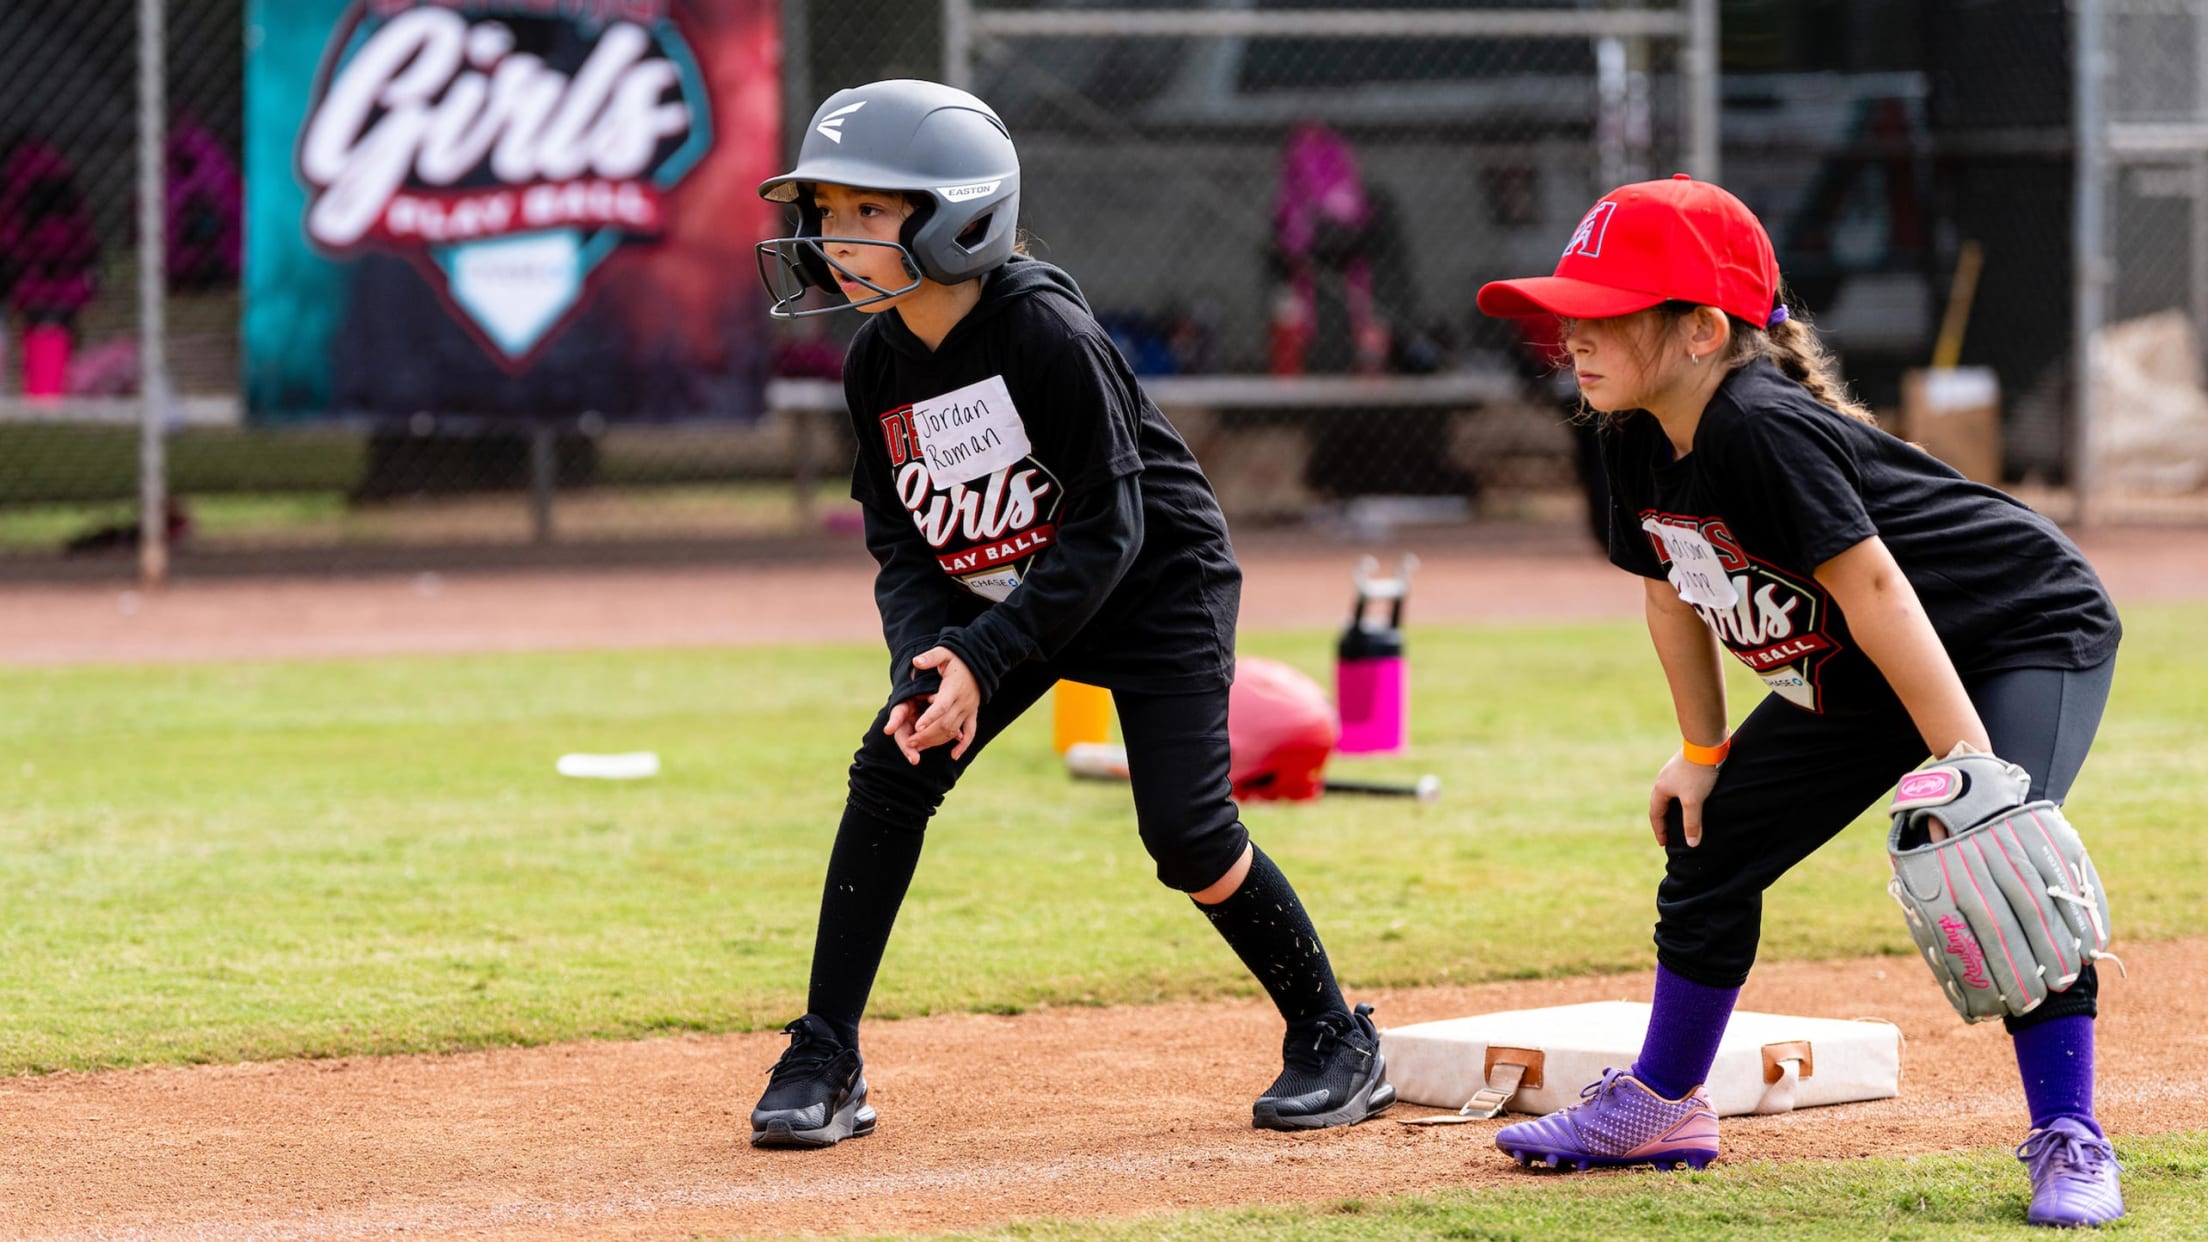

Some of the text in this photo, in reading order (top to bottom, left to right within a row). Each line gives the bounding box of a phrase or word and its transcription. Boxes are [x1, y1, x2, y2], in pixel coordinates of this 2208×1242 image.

[303, 6, 690, 246] Girls
[948, 185, 991, 196] EASTON
[915, 399, 990, 438] Jordan
[926, 427, 1002, 471] Roman
[939, 531, 1047, 572] LAY BALL
[971, 580, 1008, 588] CHASE
[1758, 641, 1815, 663] BALL
